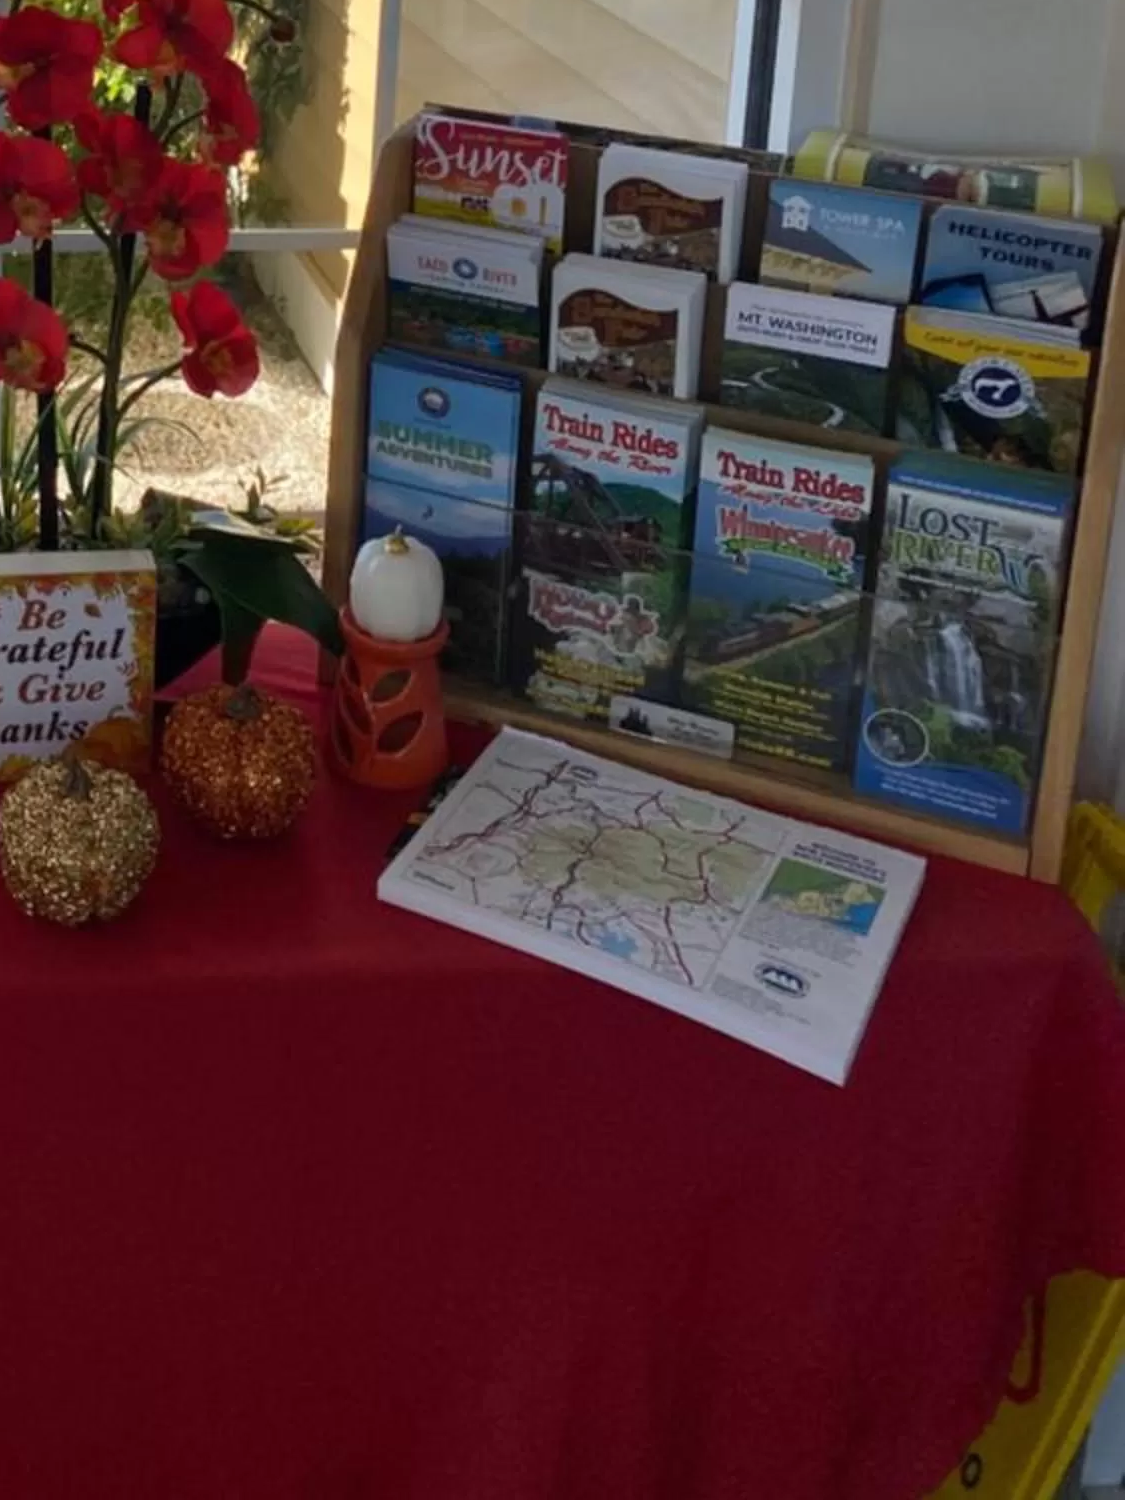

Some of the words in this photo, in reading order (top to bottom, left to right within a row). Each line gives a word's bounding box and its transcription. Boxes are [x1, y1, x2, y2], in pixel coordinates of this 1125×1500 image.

[415, 114, 568, 188] Sunset
[820, 208, 871, 227] TOWER
[948, 221, 1092, 260] HELICOPTER
[979, 247, 1055, 272] TOURS
[768, 316, 878, 346] WASHINGTON
[377, 420, 494, 464] SUMMER
[543, 403, 604, 443] Train
[612, 421, 679, 460] Rides
[376, 441, 493, 480] ADVENTURES
[717, 450, 785, 489] Train
[792, 466, 866, 504] Rides
[898, 493, 1000, 547] LOST
[892, 531, 1001, 575] RIVER
[17, 600, 67, 631] Be
[18, 665, 107, 704] Give
